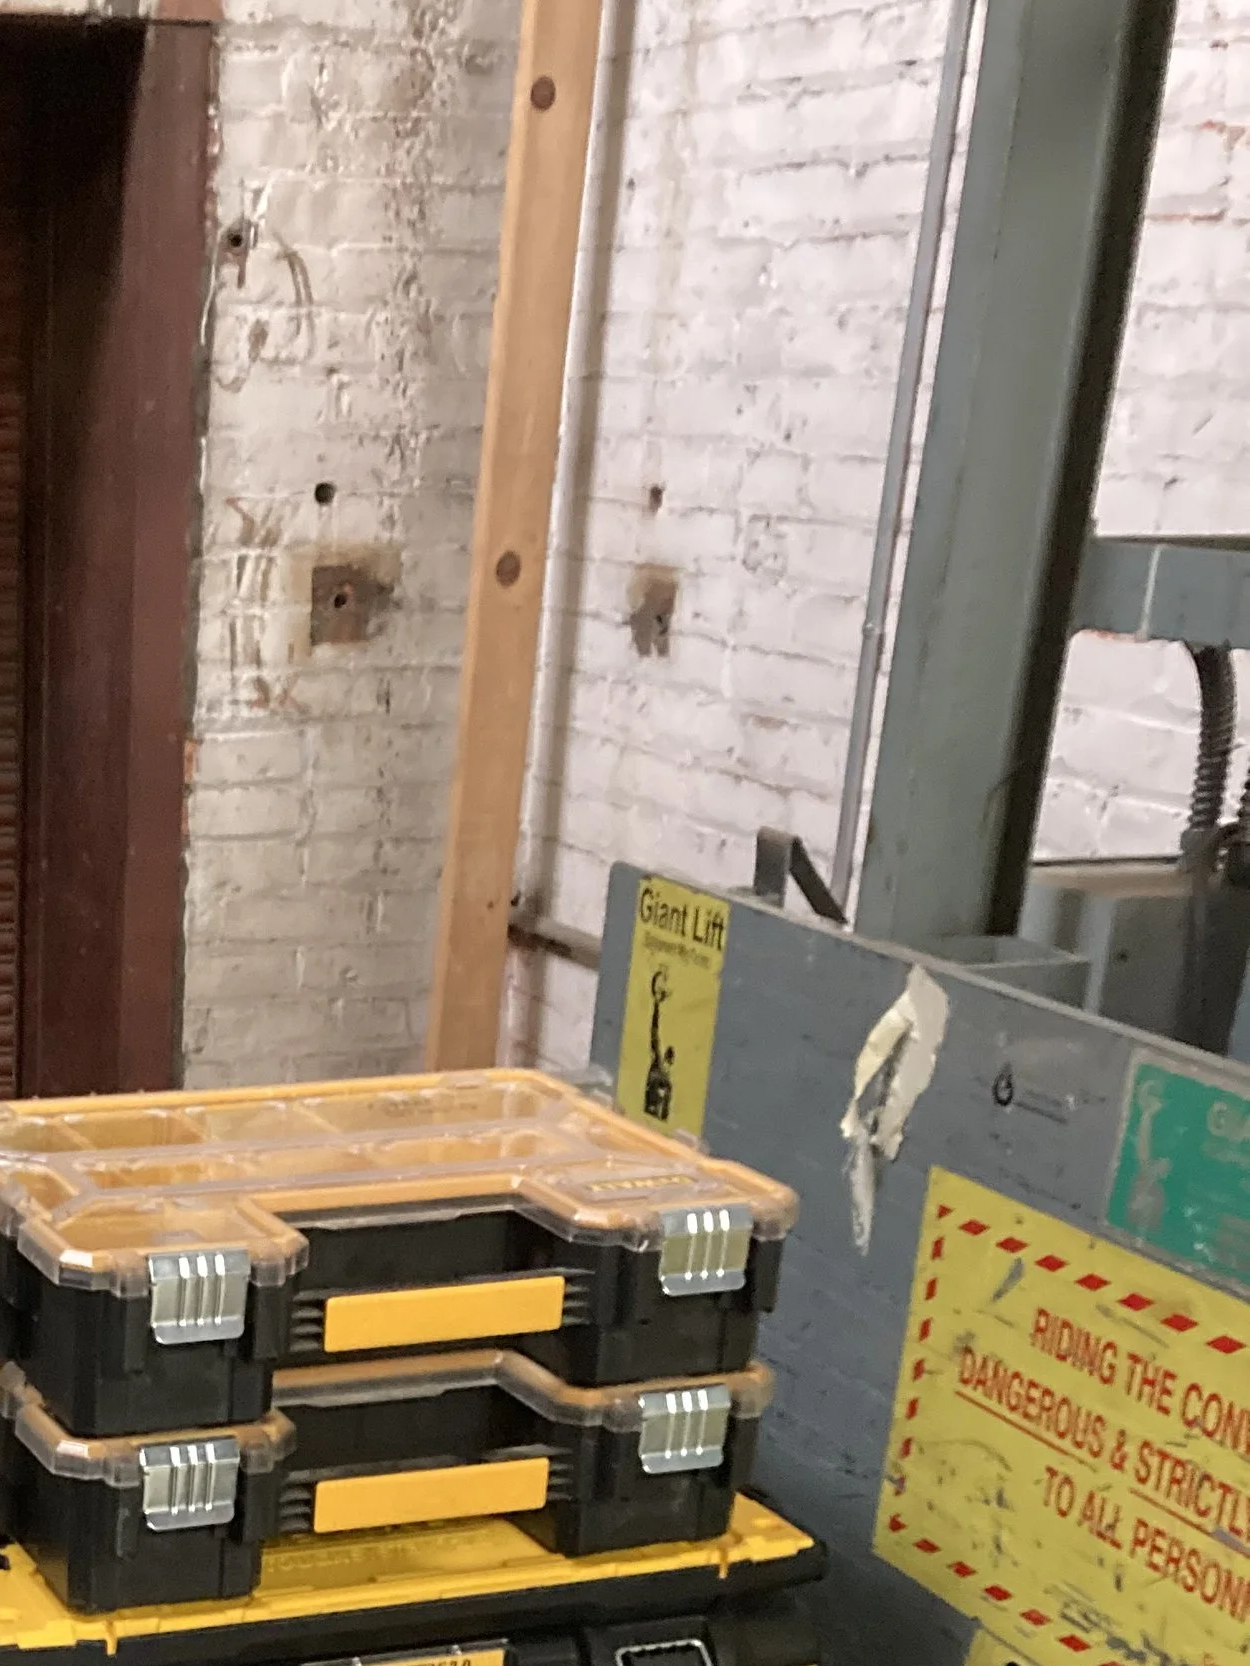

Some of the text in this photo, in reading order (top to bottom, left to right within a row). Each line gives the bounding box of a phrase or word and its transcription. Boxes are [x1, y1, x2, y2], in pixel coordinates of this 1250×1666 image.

[640, 887, 687, 937] Giant
[693, 906, 724, 951] Lift
[1030, 1307, 1118, 1385] RIDING
[1124, 1351, 1178, 1416] THE
[957, 1344, 1250, 1544] DANGEROUS & STRICTL
[1042, 1465, 1077, 1519] TO
[1078, 1490, 1122, 1551] ALL
